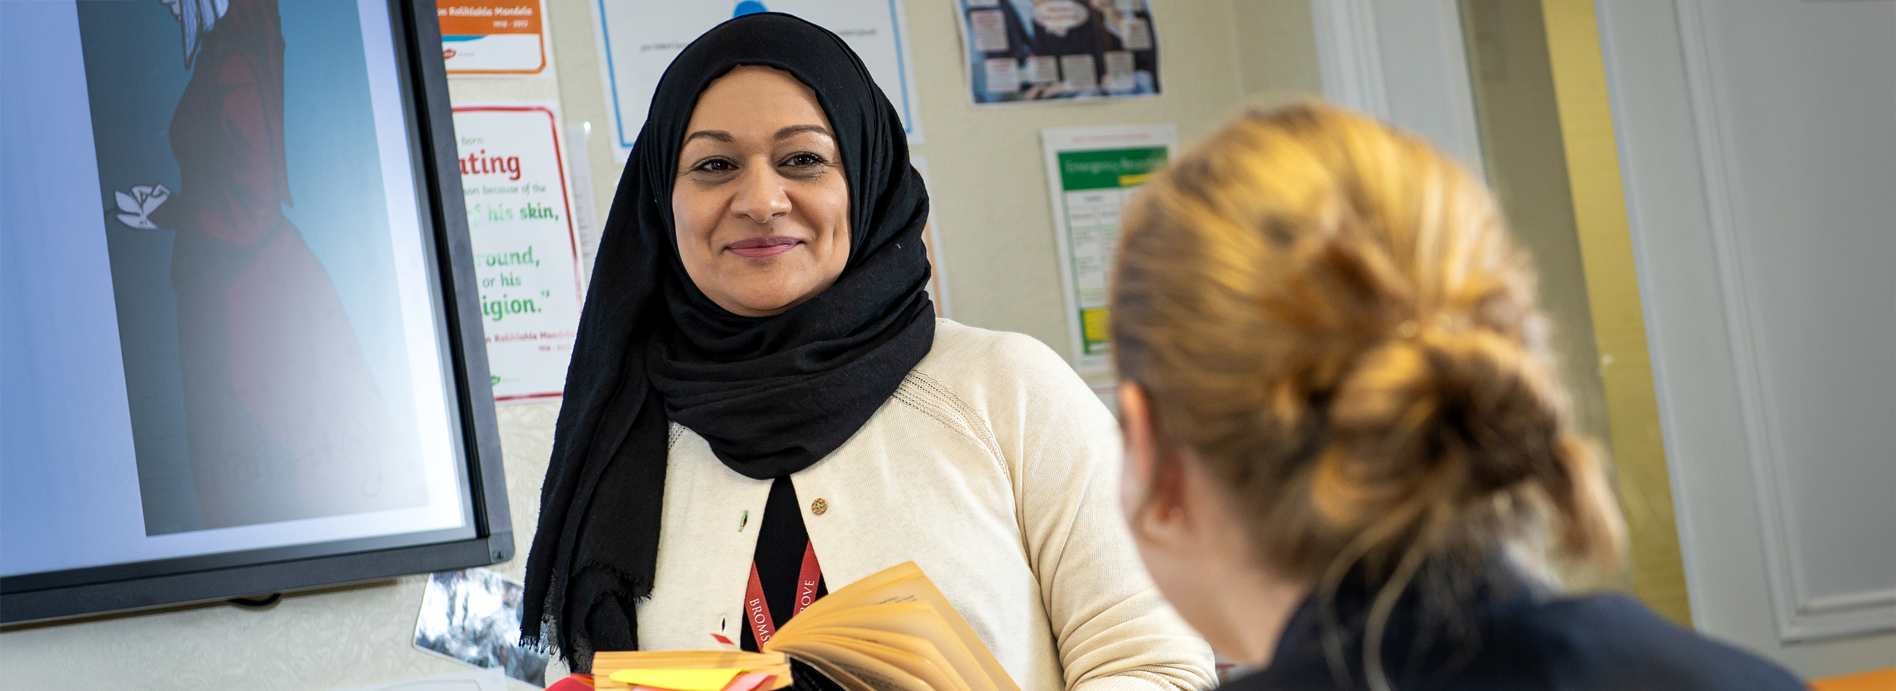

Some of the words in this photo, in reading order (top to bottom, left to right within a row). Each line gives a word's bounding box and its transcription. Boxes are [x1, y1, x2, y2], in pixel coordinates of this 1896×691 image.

[461, 136, 484, 146] born
[482, 185, 519, 196] because
[521, 182, 531, 196] of
[532, 183, 547, 193] the
[487, 203, 514, 221] his
[520, 202, 559, 222] skin,
[475, 245, 540, 267] round,
[482, 277, 496, 288] or
[500, 272, 522, 288] his
